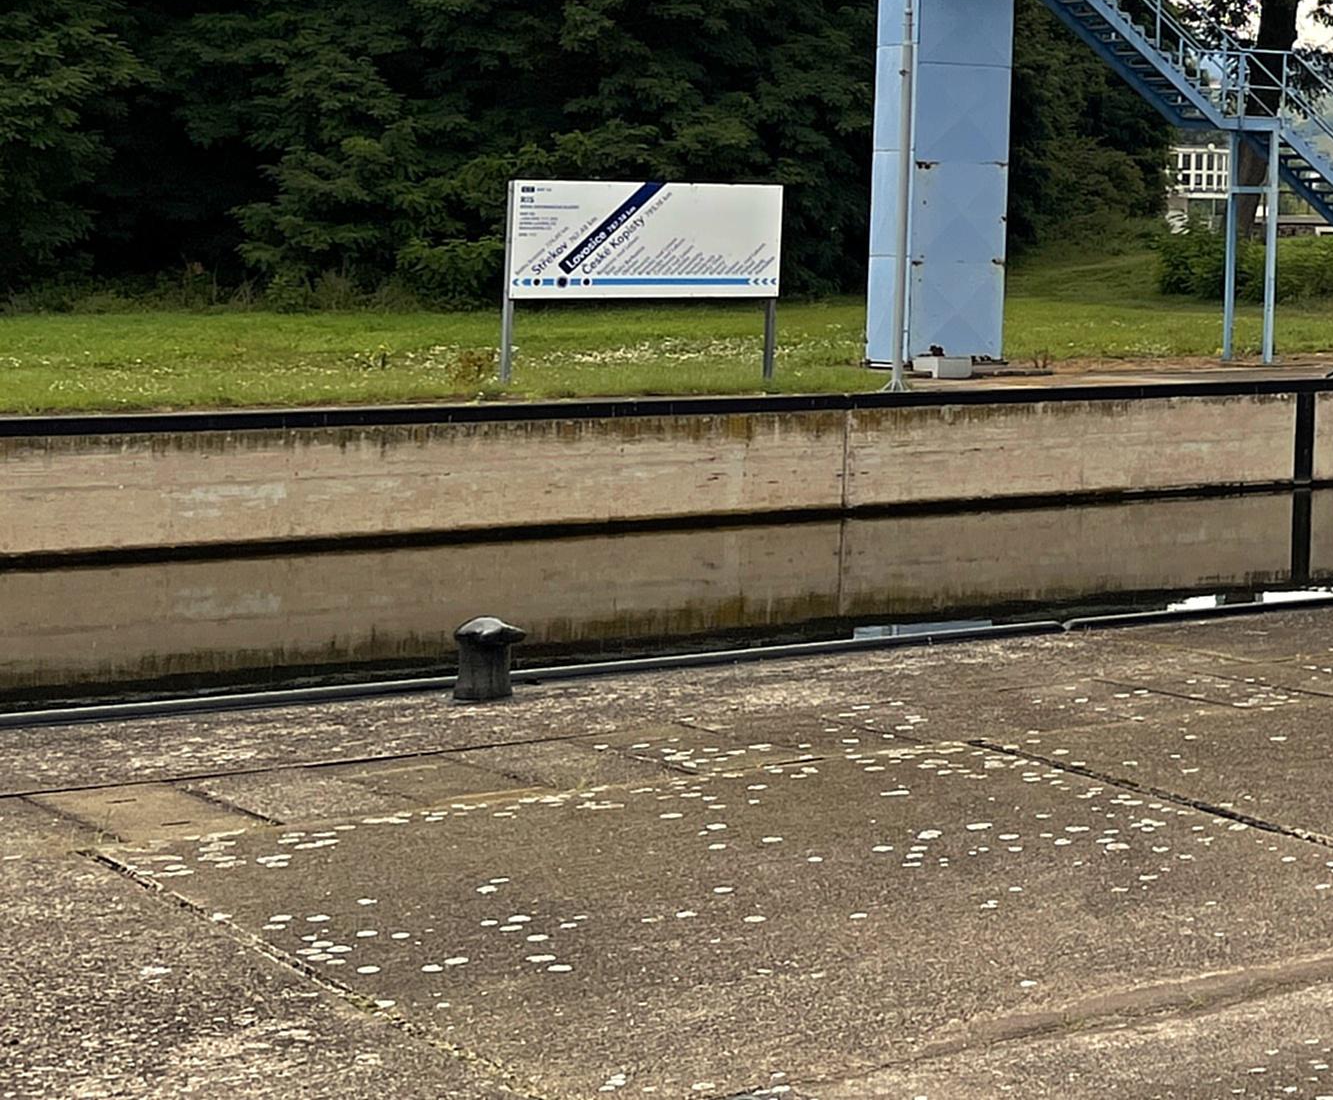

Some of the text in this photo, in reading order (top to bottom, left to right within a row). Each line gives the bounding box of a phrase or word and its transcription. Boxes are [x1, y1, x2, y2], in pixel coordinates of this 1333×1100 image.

[565, 231, 607, 269] Lovosice
[582, 245, 612, 274] České
[609, 216, 645, 249] Kopisty
